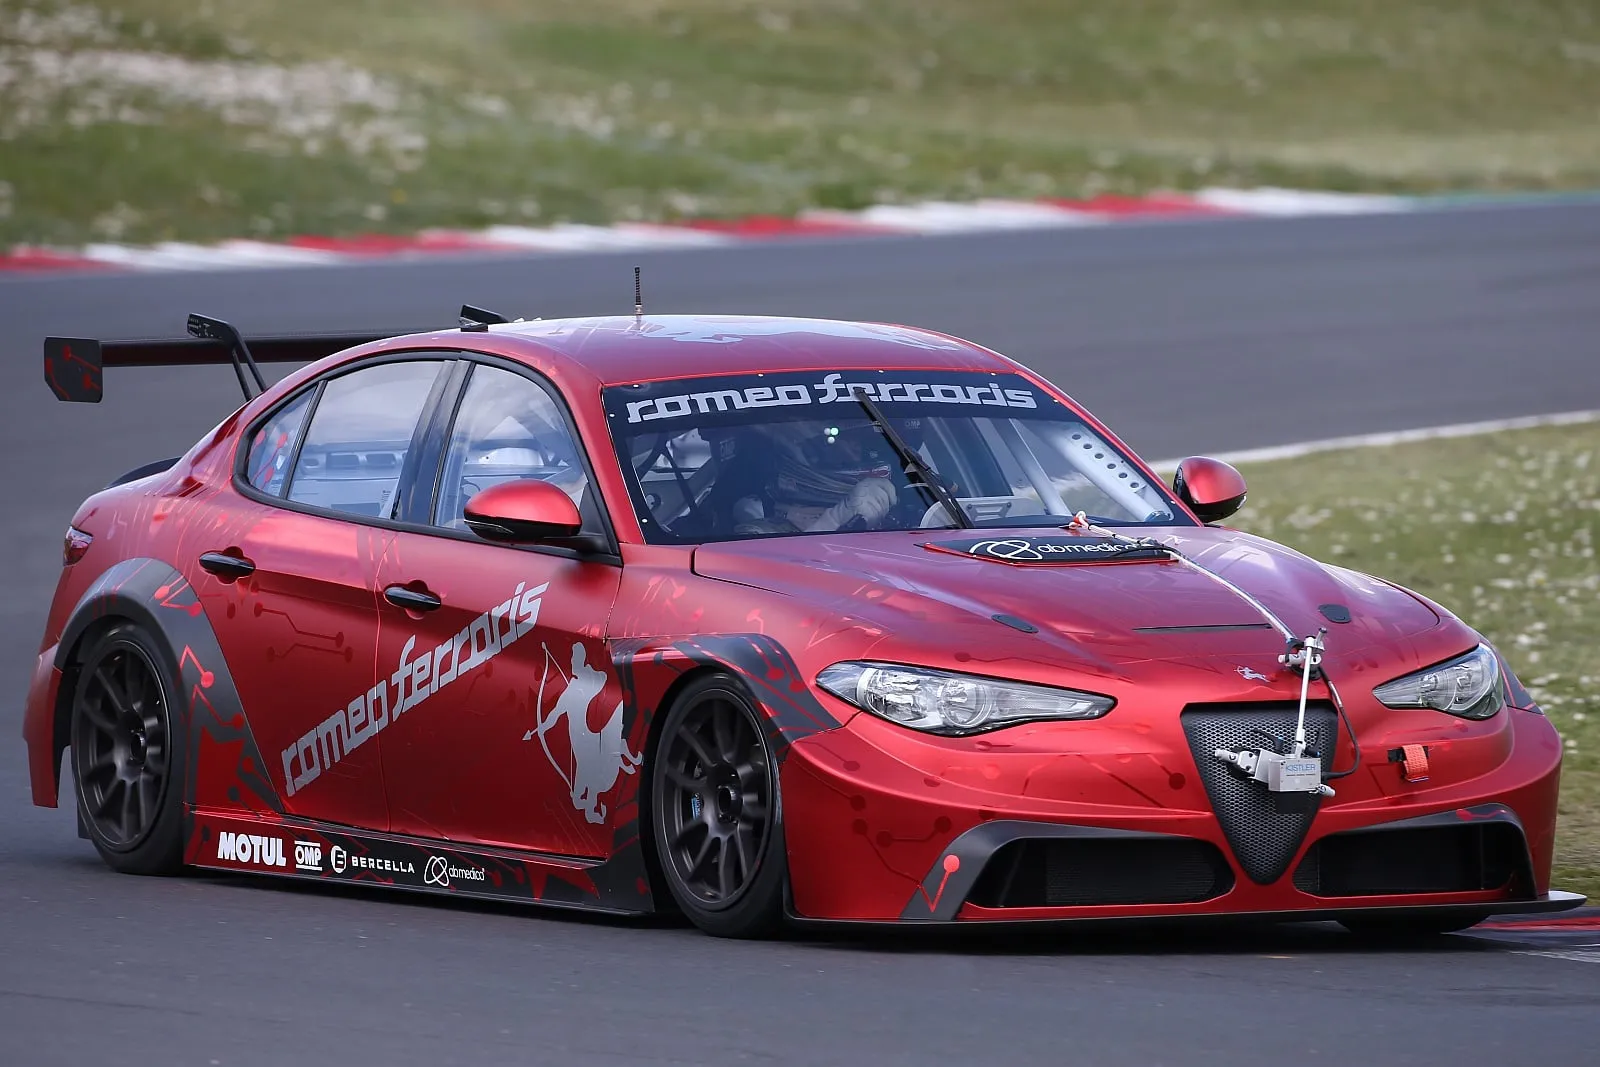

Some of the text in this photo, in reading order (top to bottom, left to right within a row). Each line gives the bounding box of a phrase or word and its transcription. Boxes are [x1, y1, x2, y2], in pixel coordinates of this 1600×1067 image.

[627, 373, 1037, 423] romeo ferraris
[281, 581, 549, 797] romeo ferraris
[1285, 763, 1316, 772] KISTLER
[217, 831, 286, 866] MOTUL
[294, 844, 322, 867] OMP
[351, 855, 415, 874] BERCELLA
